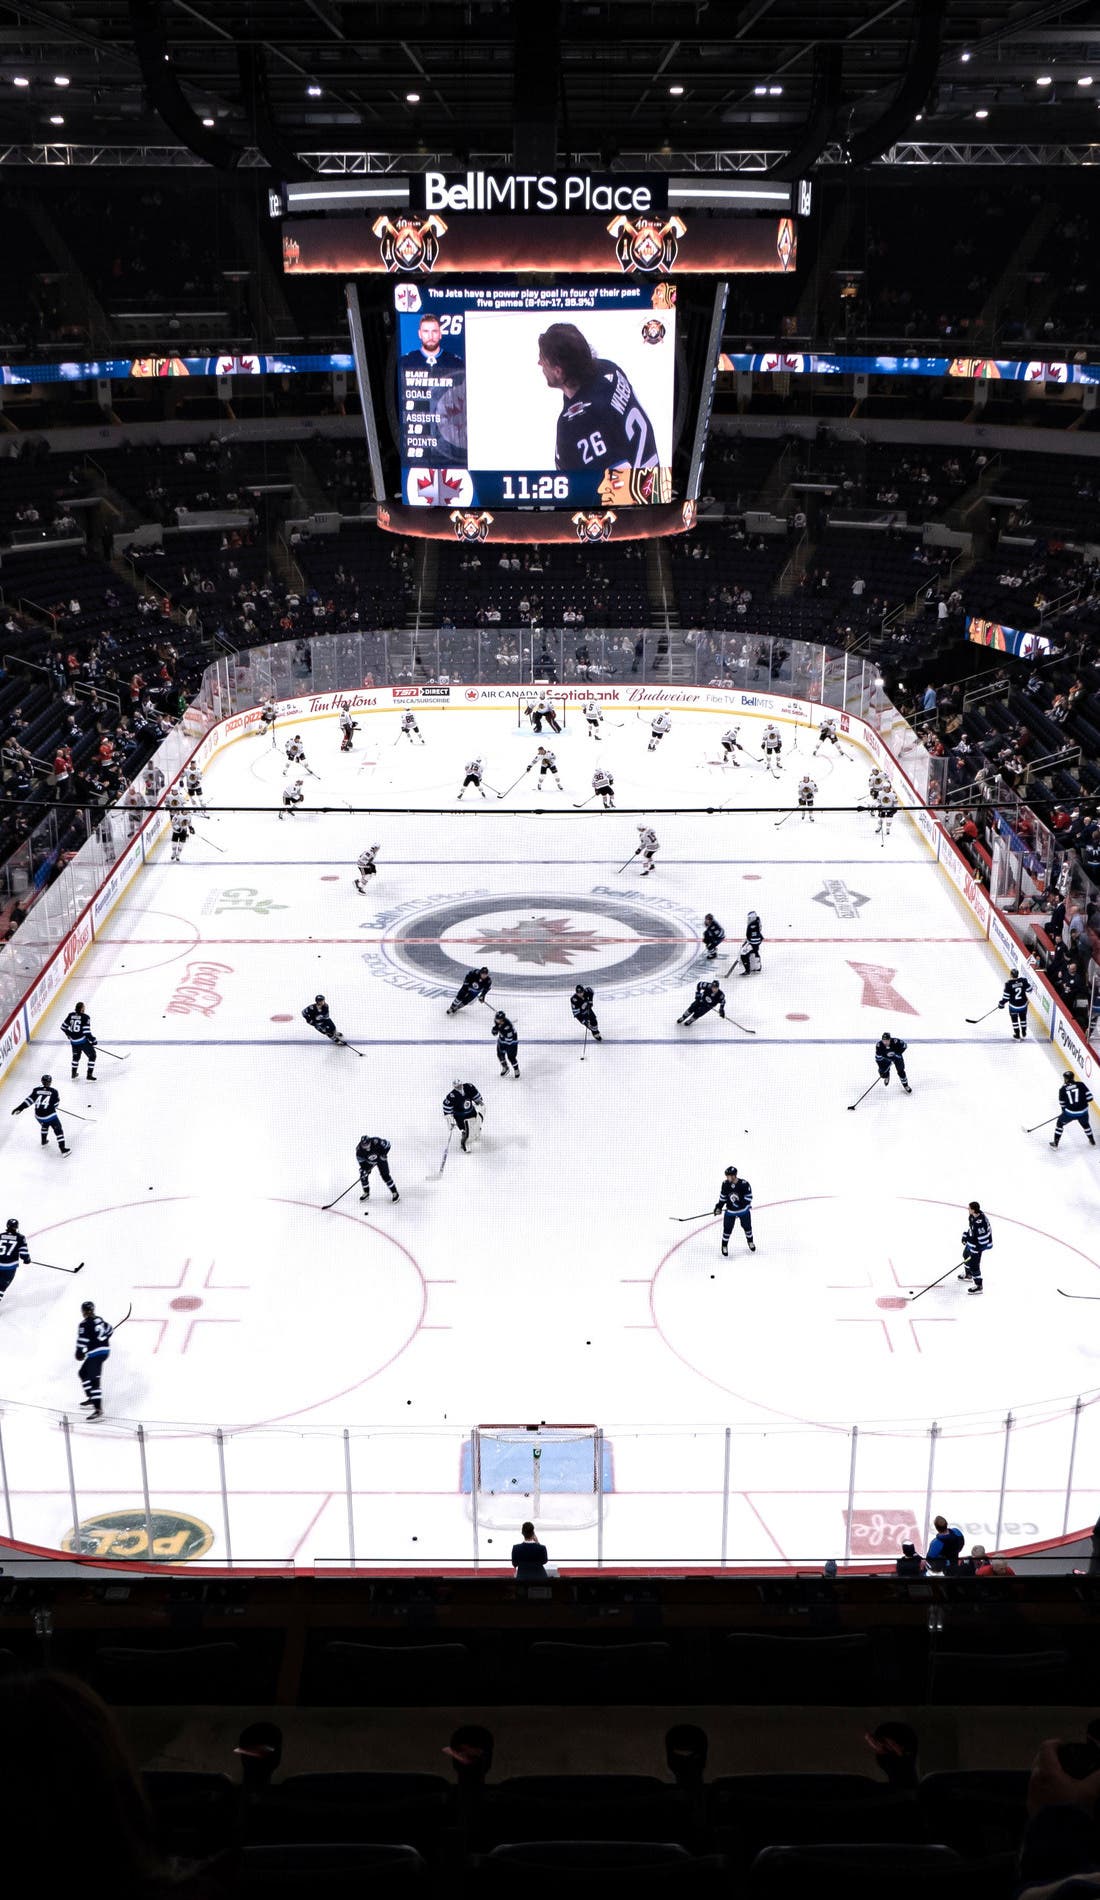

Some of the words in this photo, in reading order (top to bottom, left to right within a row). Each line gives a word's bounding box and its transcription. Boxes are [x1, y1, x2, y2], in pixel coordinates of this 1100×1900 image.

[425, 171, 558, 210] BellMTS
[565, 176, 651, 210] Place
[428, 289, 444, 297] The
[445, 289, 463, 297] Jets
[464, 288, 485, 297] have
[493, 290, 519, 299] power
[521, 288, 539, 299] play
[541, 288, 559, 299] goal
[560, 288, 568, 297] in
[569, 288, 587, 297] four
[589, 288, 598, 297] of
[599, 288, 619, 297] their
[621, 288, 640, 298] past
[477, 299, 493, 307] five
[494, 301, 523, 309] games
[439, 315, 463, 335] 26
[406, 378, 453, 387] WHEELER
[405, 390, 432, 399] GOALS
[406, 414, 441, 422] ASSISTS
[407, 438, 438, 447] POINTS
[577, 431, 607, 465] 26
[502, 476, 569, 499] 11:26
[394, 688, 418, 696] TSN
[546, 689, 620, 701] Scotiabank
[626, 687, 701, 702] Budweiser
[724, 695, 736, 704] TV
[309, 697, 329, 712] Tim
[331, 694, 377, 710] Hortons
[741, 695, 774, 709] BellMTS
[243, 711, 262, 728] pizz
[1014, 987, 1023, 1000] 2
[1058, 1019, 1084, 1069] Payworks
[35, 1095, 50, 1110] 44
[1066, 1088, 1079, 1104] 17
[0, 1240, 18, 1256] 57
[853, 1514, 919, 1547] life
[90, 1529, 191, 1556] PCL
